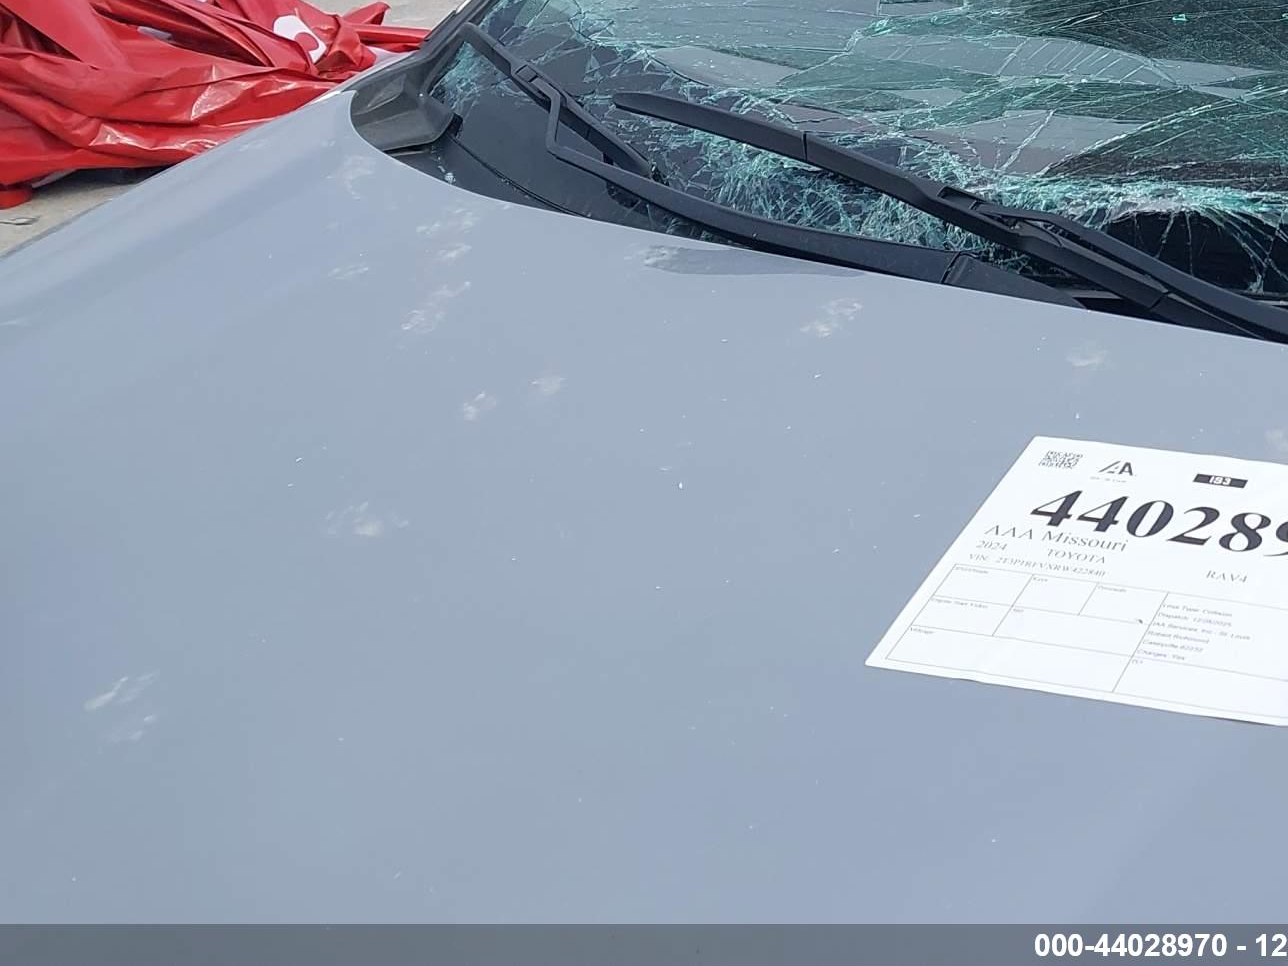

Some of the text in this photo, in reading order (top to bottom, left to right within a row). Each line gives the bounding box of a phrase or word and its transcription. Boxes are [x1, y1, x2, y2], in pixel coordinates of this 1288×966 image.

[984, 524, 1129, 553] AAA Missouri
[975, 540, 1248, 583] 2024 TOYOTA RAV4
